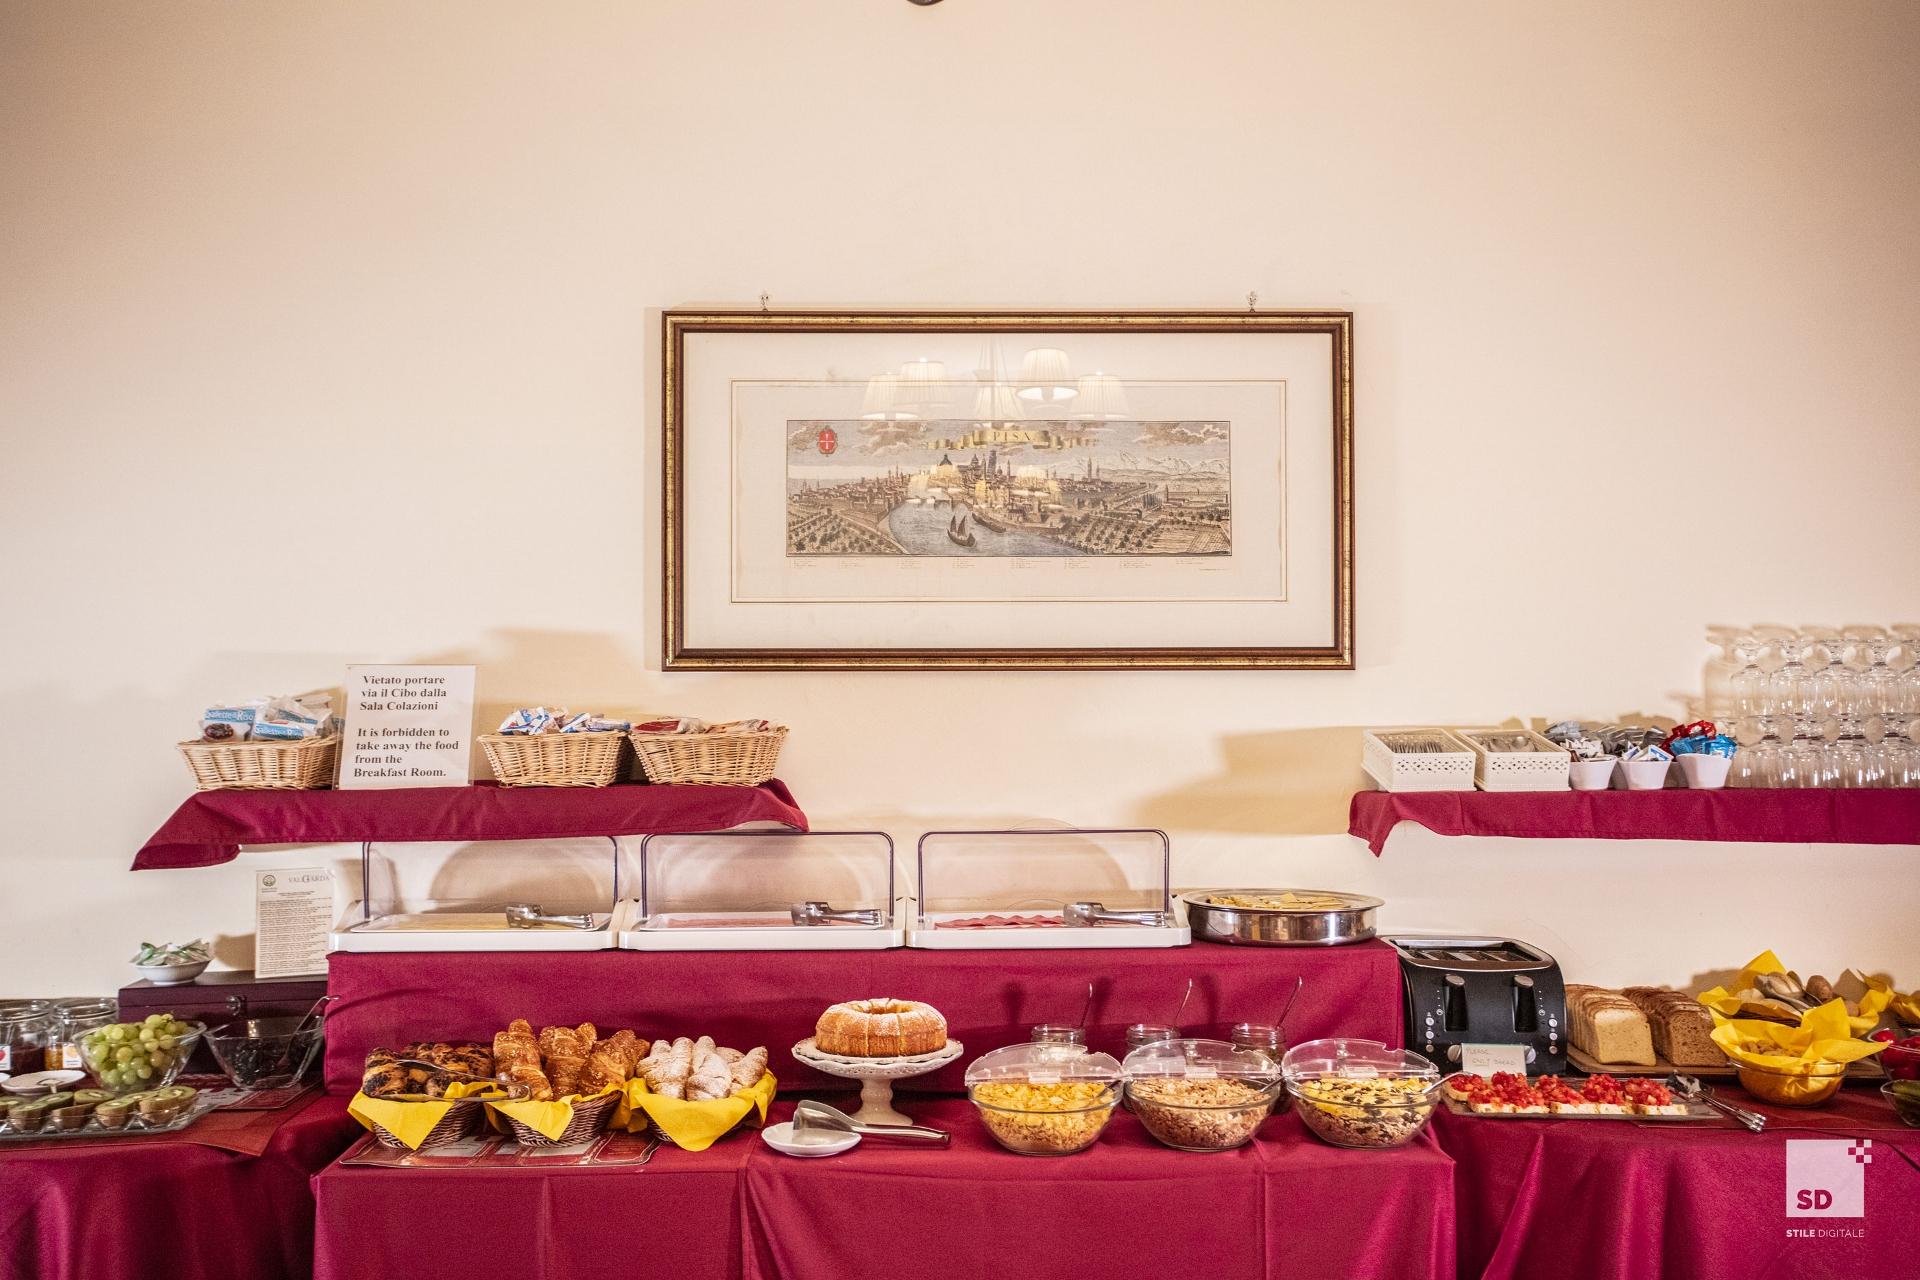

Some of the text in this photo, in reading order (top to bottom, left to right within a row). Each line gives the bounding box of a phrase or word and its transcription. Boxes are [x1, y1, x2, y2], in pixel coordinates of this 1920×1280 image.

[993, 431, 1031, 441] PISA
[362, 675, 446, 686] Vietato portare
[361, 688, 447, 698] via il Cibo dalla
[360, 701, 438, 711] Sala Colazioni
[357, 727, 450, 737] It is forbidden to
[356, 741, 459, 752] take away the food
[355, 755, 402, 764] from the
[353, 768, 447, 777] Breakfast Room.
